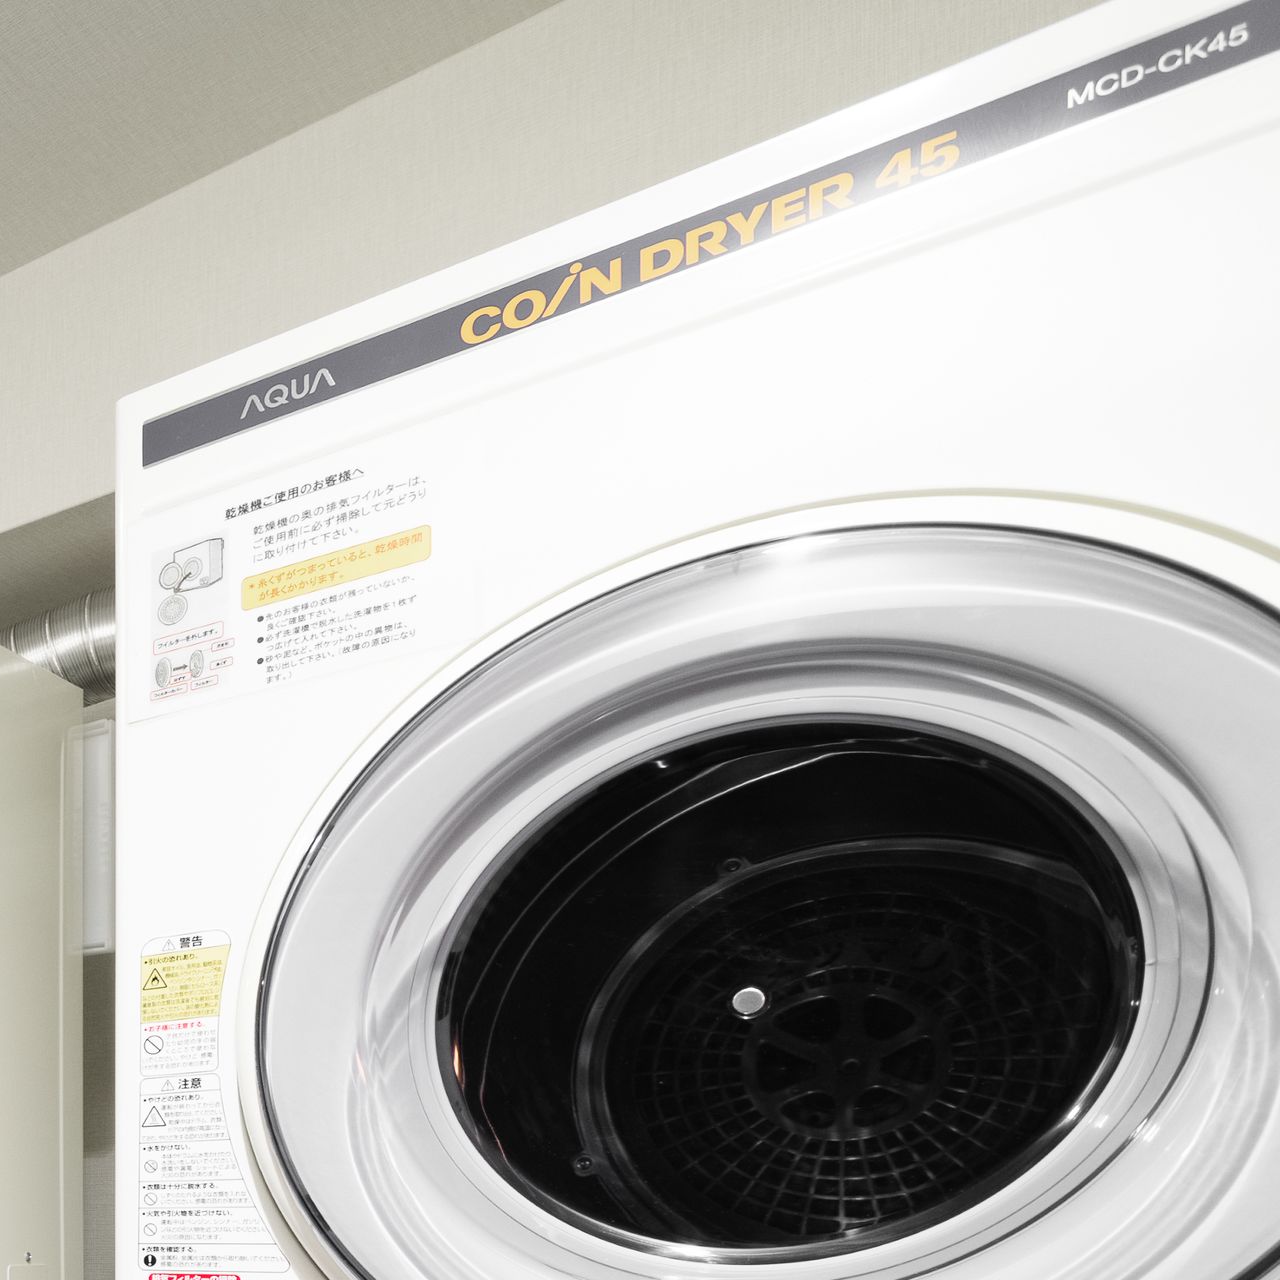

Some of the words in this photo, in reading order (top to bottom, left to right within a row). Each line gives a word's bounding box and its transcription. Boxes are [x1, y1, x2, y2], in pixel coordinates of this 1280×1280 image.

[1067, 22, 1249, 109] MCD-CK45
[460, 257, 622, 345] COIN
[640, 172, 857, 282] DRYER
[875, 130, 959, 191] 45
[240, 368, 336, 420] AQUA
[224, 468, 365, 519] 乾燥機ご使用のお客様へ
[180, 936, 203, 948] 警告
[178, 1078, 202, 1090] 注意
